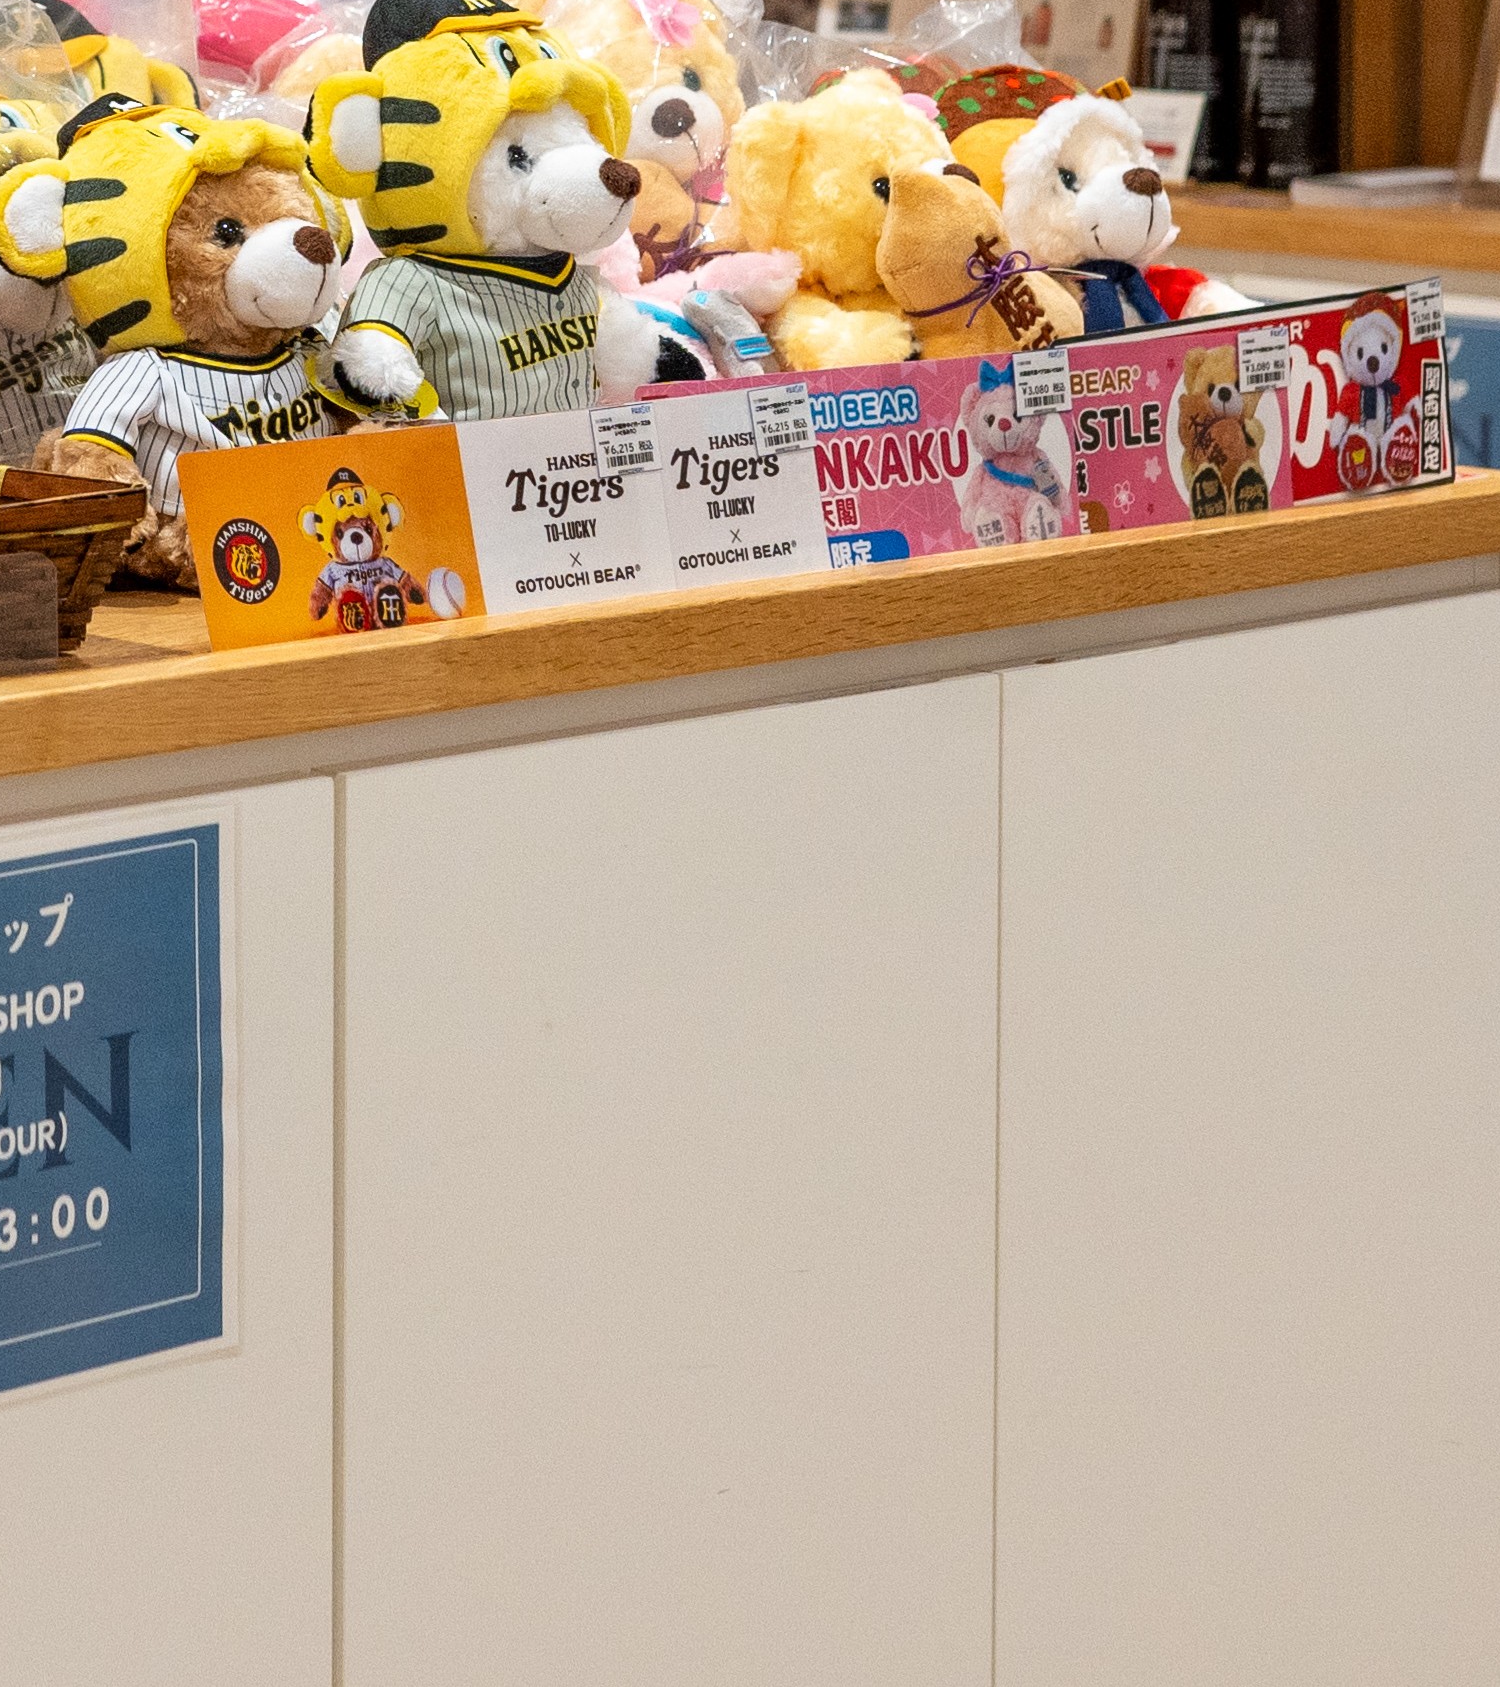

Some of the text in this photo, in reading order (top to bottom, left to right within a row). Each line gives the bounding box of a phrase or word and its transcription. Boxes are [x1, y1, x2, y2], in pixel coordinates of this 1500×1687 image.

[500, 315, 599, 372] HANSH
[211, 392, 322, 448] Tiger
[842, 391, 917, 424] BEAR
[670, 447, 780, 495] Tigers
[814, 429, 970, 493] NKAKU
[505, 468, 625, 518] Tigers
[707, 496, 755, 520] TO-LUCKY
[822, 497, 858, 529] 天閣
[215, 522, 267, 550] HANSHIN
[544, 518, 597, 543] TO-LUCKY
[678, 547, 750, 570] GOTOUCHI
[228, 577, 275, 605] Tigers
[515, 568, 591, 594] GOTOUCHI
